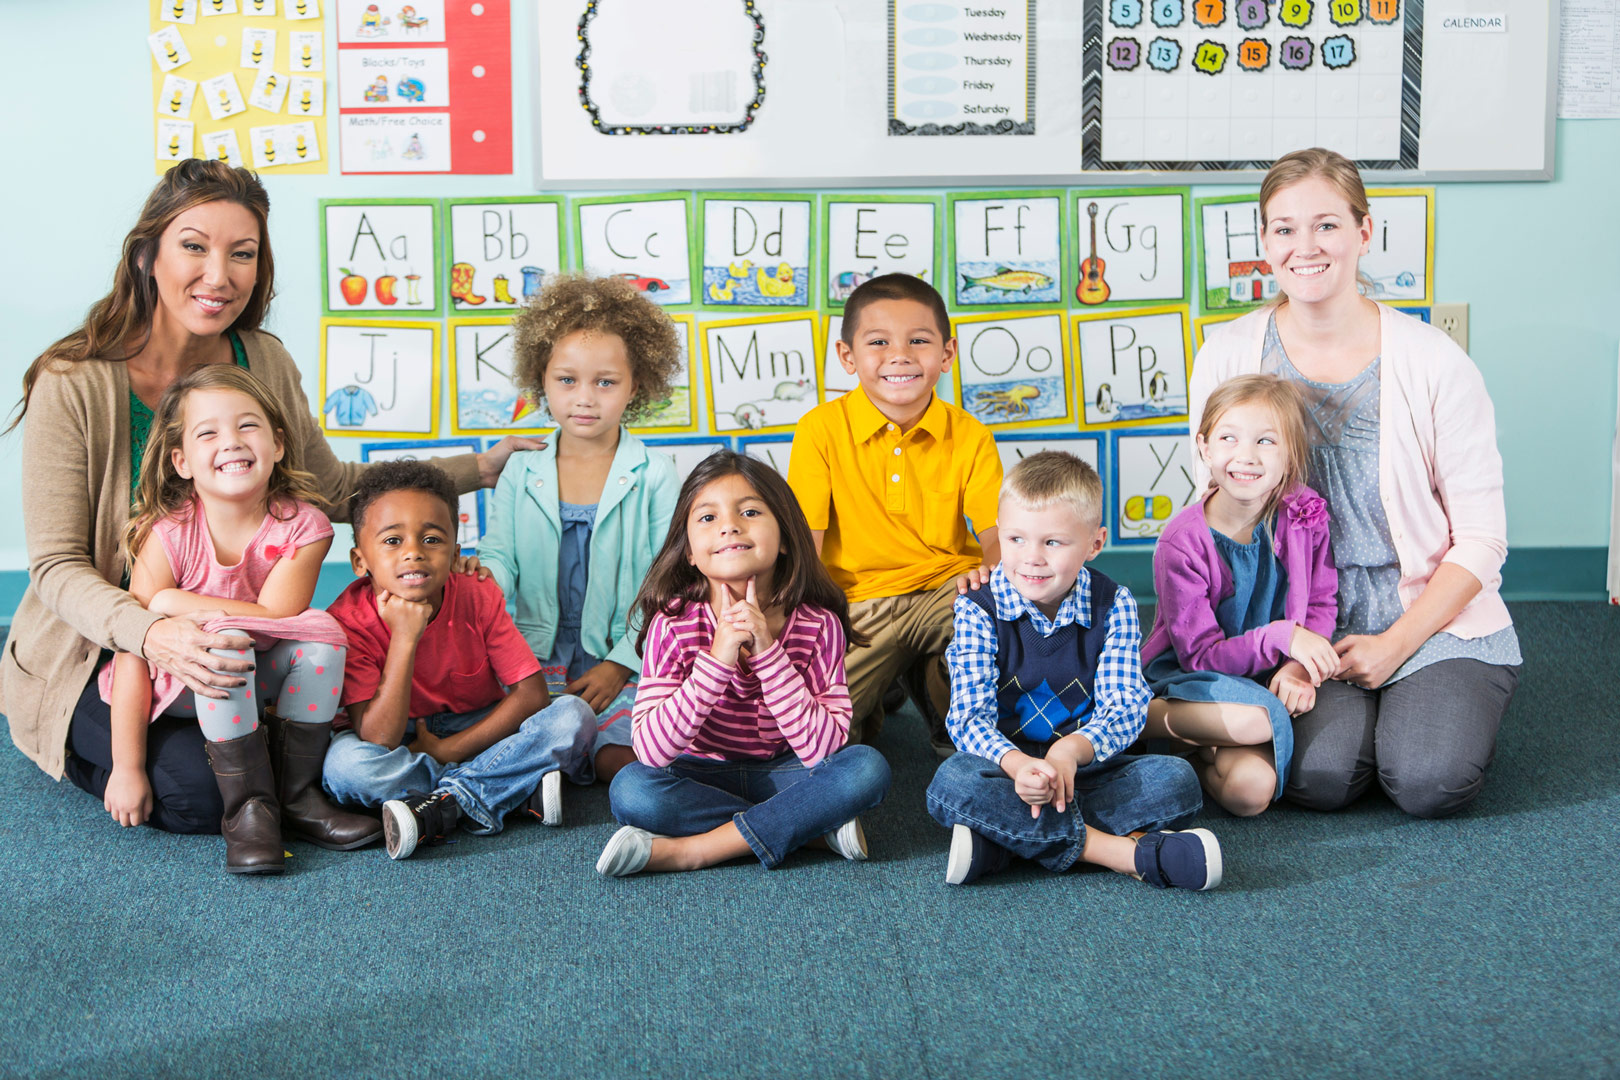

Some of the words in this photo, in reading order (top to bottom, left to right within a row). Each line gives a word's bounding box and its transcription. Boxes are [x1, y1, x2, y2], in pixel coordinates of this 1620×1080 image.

[964, 8, 1007, 18] Tuesday
[1121, 4, 1131, 18] 5
[1162, 4, 1173, 18] 6
[1204, 4, 1214, 18] 7
[1247, 5, 1258, 20] 8
[1291, 4, 1302, 17] 9
[1337, 3, 1354, 17] 10
[1377, 1, 1389, 14] 11
[1443, 17, 1502, 28] CALENDAR
[963, 32, 1022, 43] Wednesday
[1116, 47, 1131, 61] 12
[1157, 47, 1172, 62] 13
[1202, 49, 1217, 65] 14
[1246, 47, 1261, 61] 15
[1289, 45, 1304, 60] 16
[1330, 45, 1345, 59] 17
[964, 56, 1012, 68] Thursday
[963, 80, 995, 91] Friday
[963, 105, 1010, 116] Saturday
[408, 116, 444, 127] Choice
[1225, 207, 1260, 260] H
[474, 331, 510, 382] K
